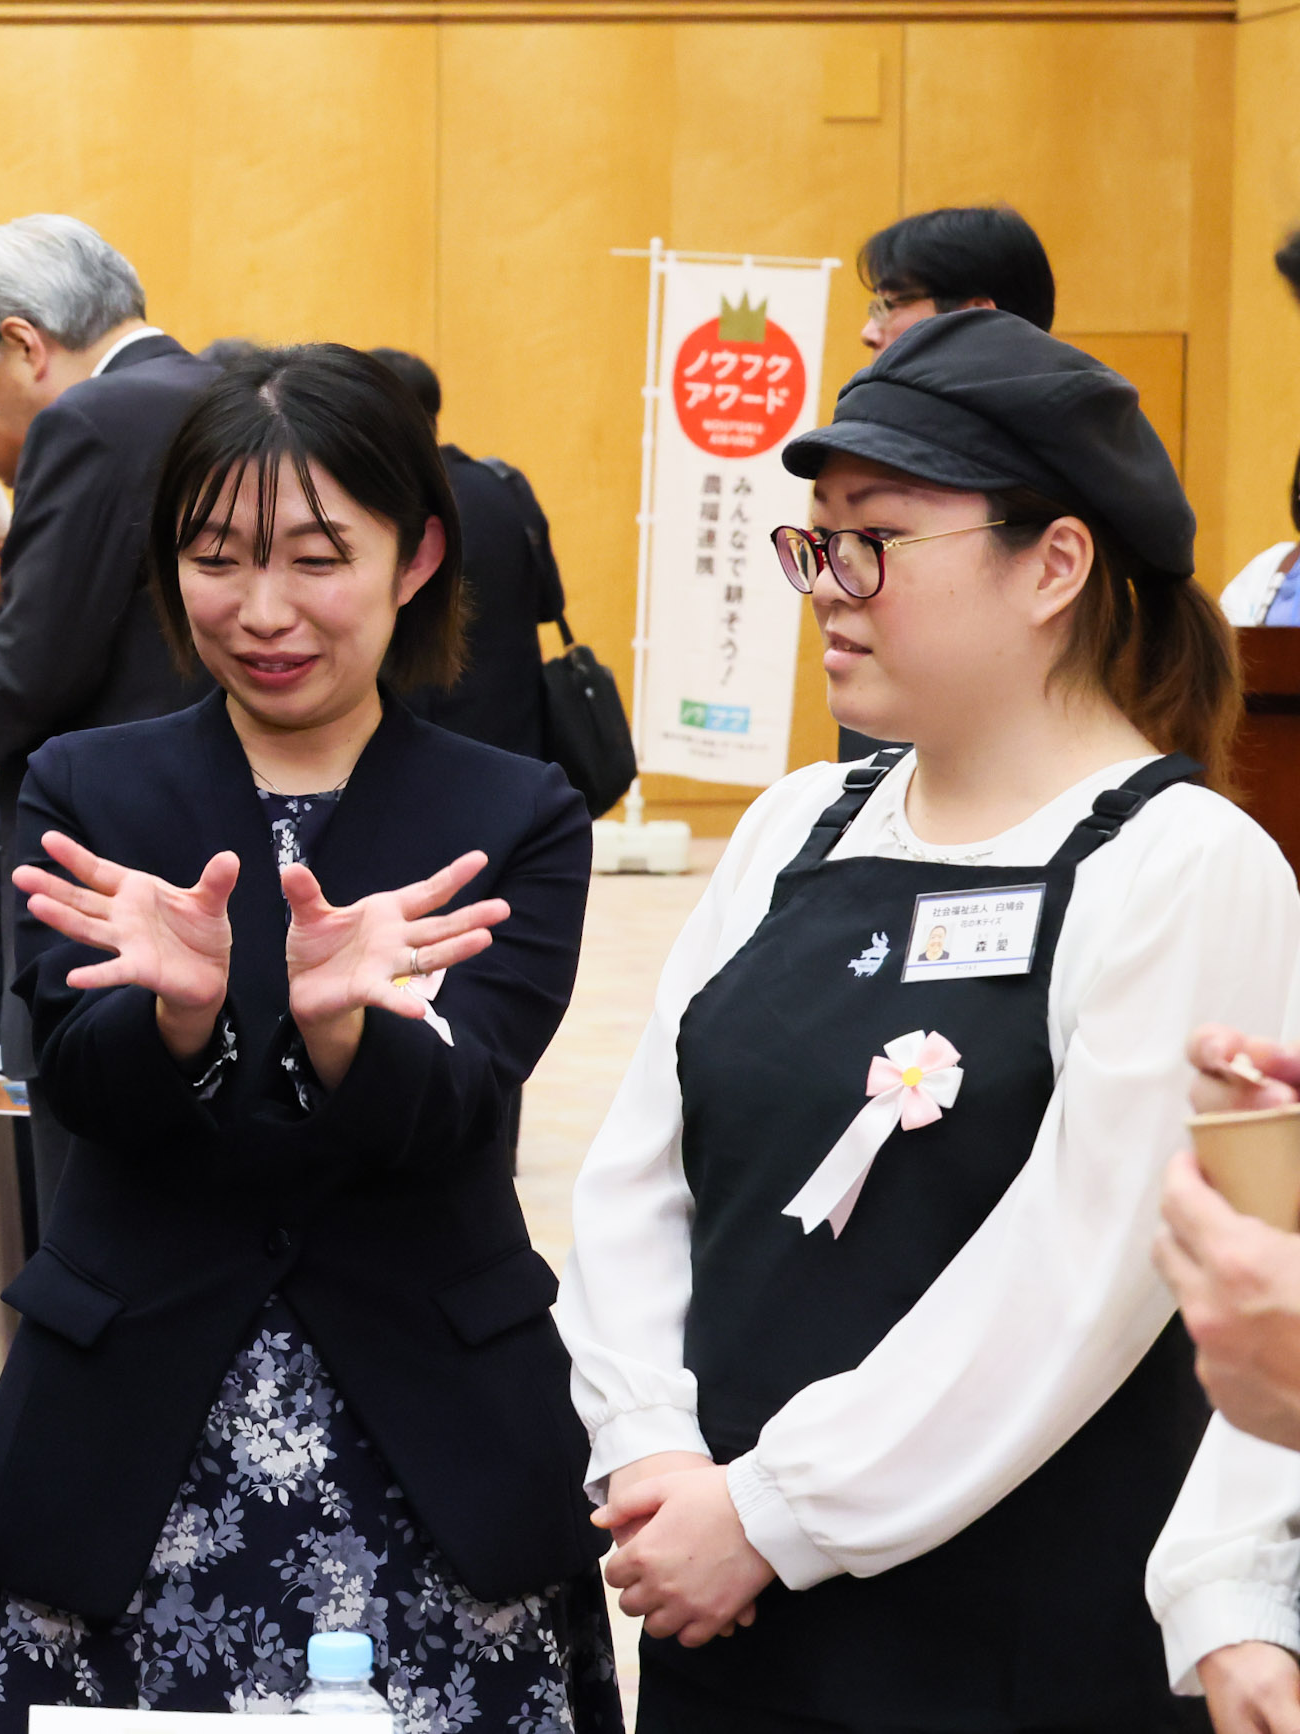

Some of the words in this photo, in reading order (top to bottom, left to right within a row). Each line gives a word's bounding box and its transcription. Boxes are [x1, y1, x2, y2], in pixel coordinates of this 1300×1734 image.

[684, 350, 791, 382] ノウフク
[684, 382, 790, 414] アワード
[932, 905, 989, 918] 社会福祉法人
[995, 901, 1025, 913] 白鳩会
